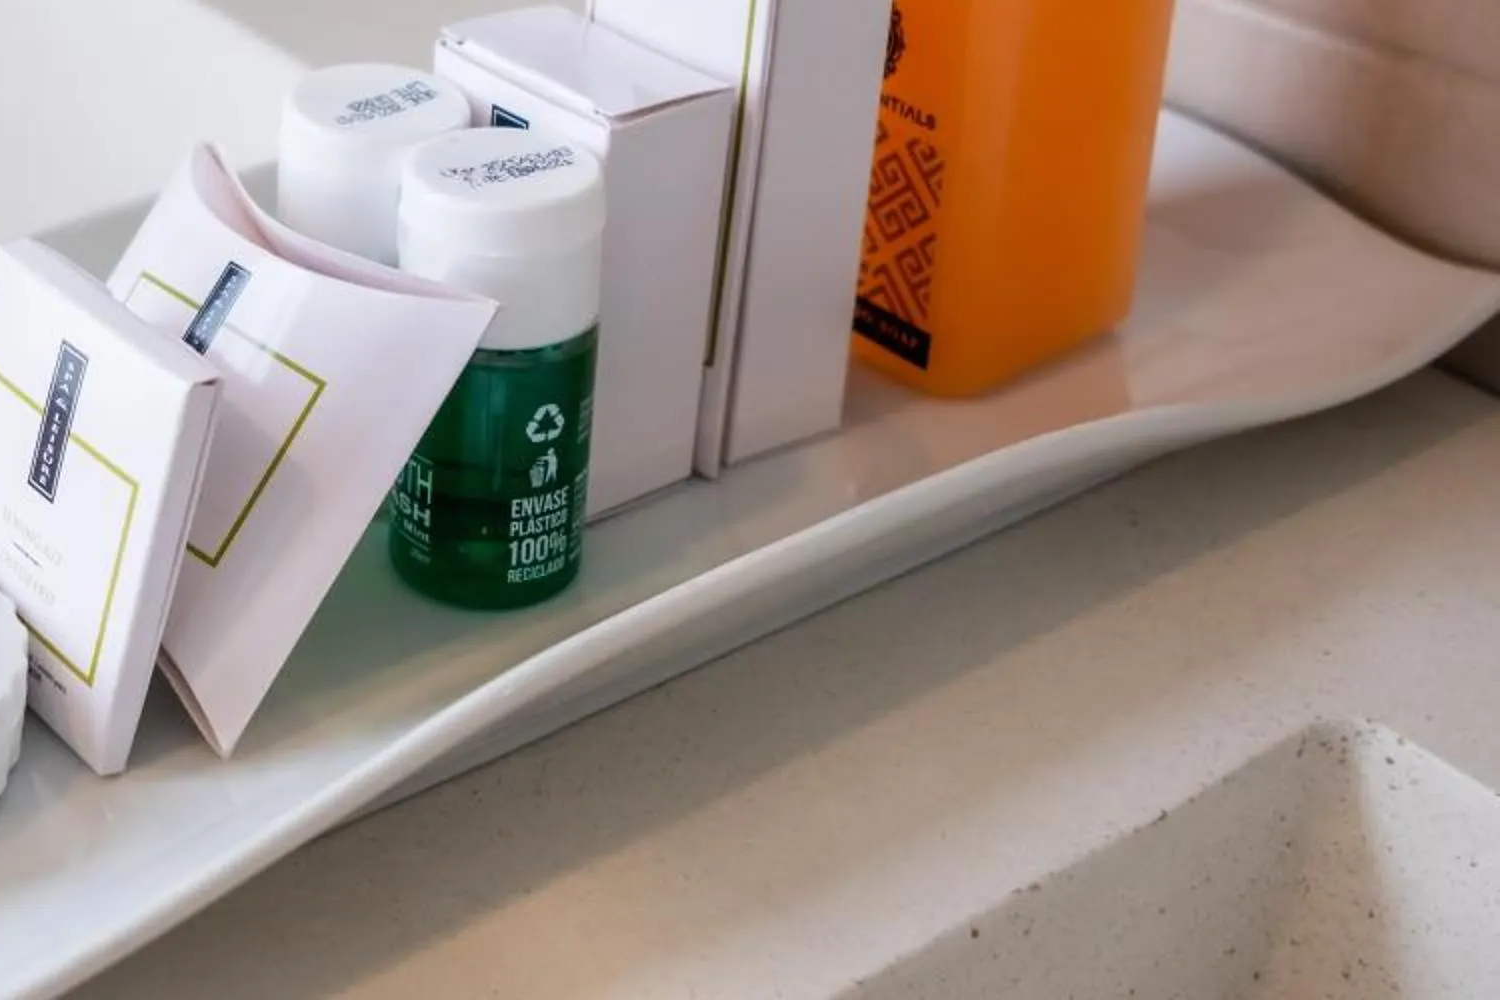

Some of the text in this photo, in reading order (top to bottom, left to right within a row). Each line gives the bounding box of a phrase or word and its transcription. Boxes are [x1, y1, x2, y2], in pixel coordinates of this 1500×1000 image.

[880, 95, 936, 130] NTIALS
[511, 485, 569, 518] ENVASE
[508, 529, 567, 566] 100%
